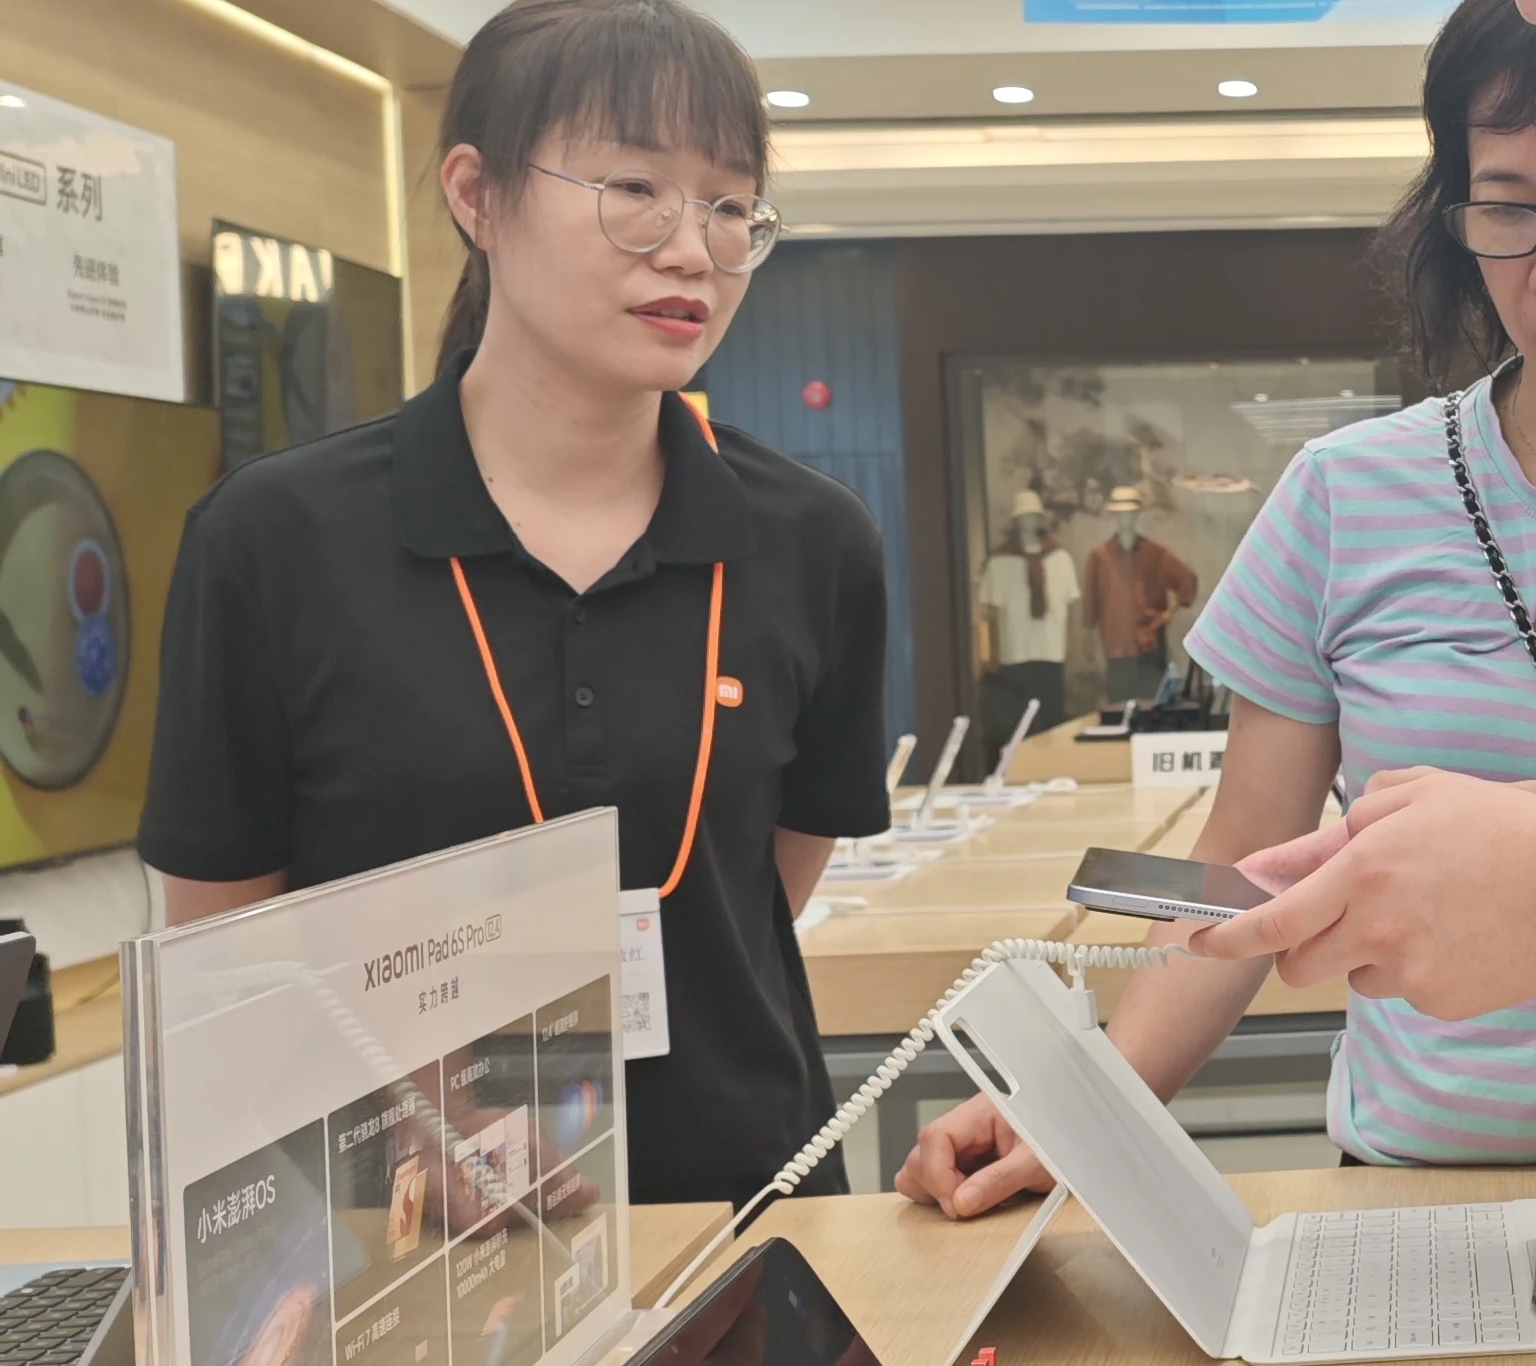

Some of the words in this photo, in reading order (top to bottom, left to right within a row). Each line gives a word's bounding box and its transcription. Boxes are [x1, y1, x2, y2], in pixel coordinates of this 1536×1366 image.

[57, 164, 103, 222] 系列
[428, 934, 450, 967] Pad
[451, 929, 465, 958] 6S
[466, 924, 484, 950] Pro
[418, 977, 459, 1015] 实力跨越
[450, 1074, 460, 1092] PC
[197, 1174, 276, 1244] 小米澎湃OS
[365, 1328, 371, 1347] 7
